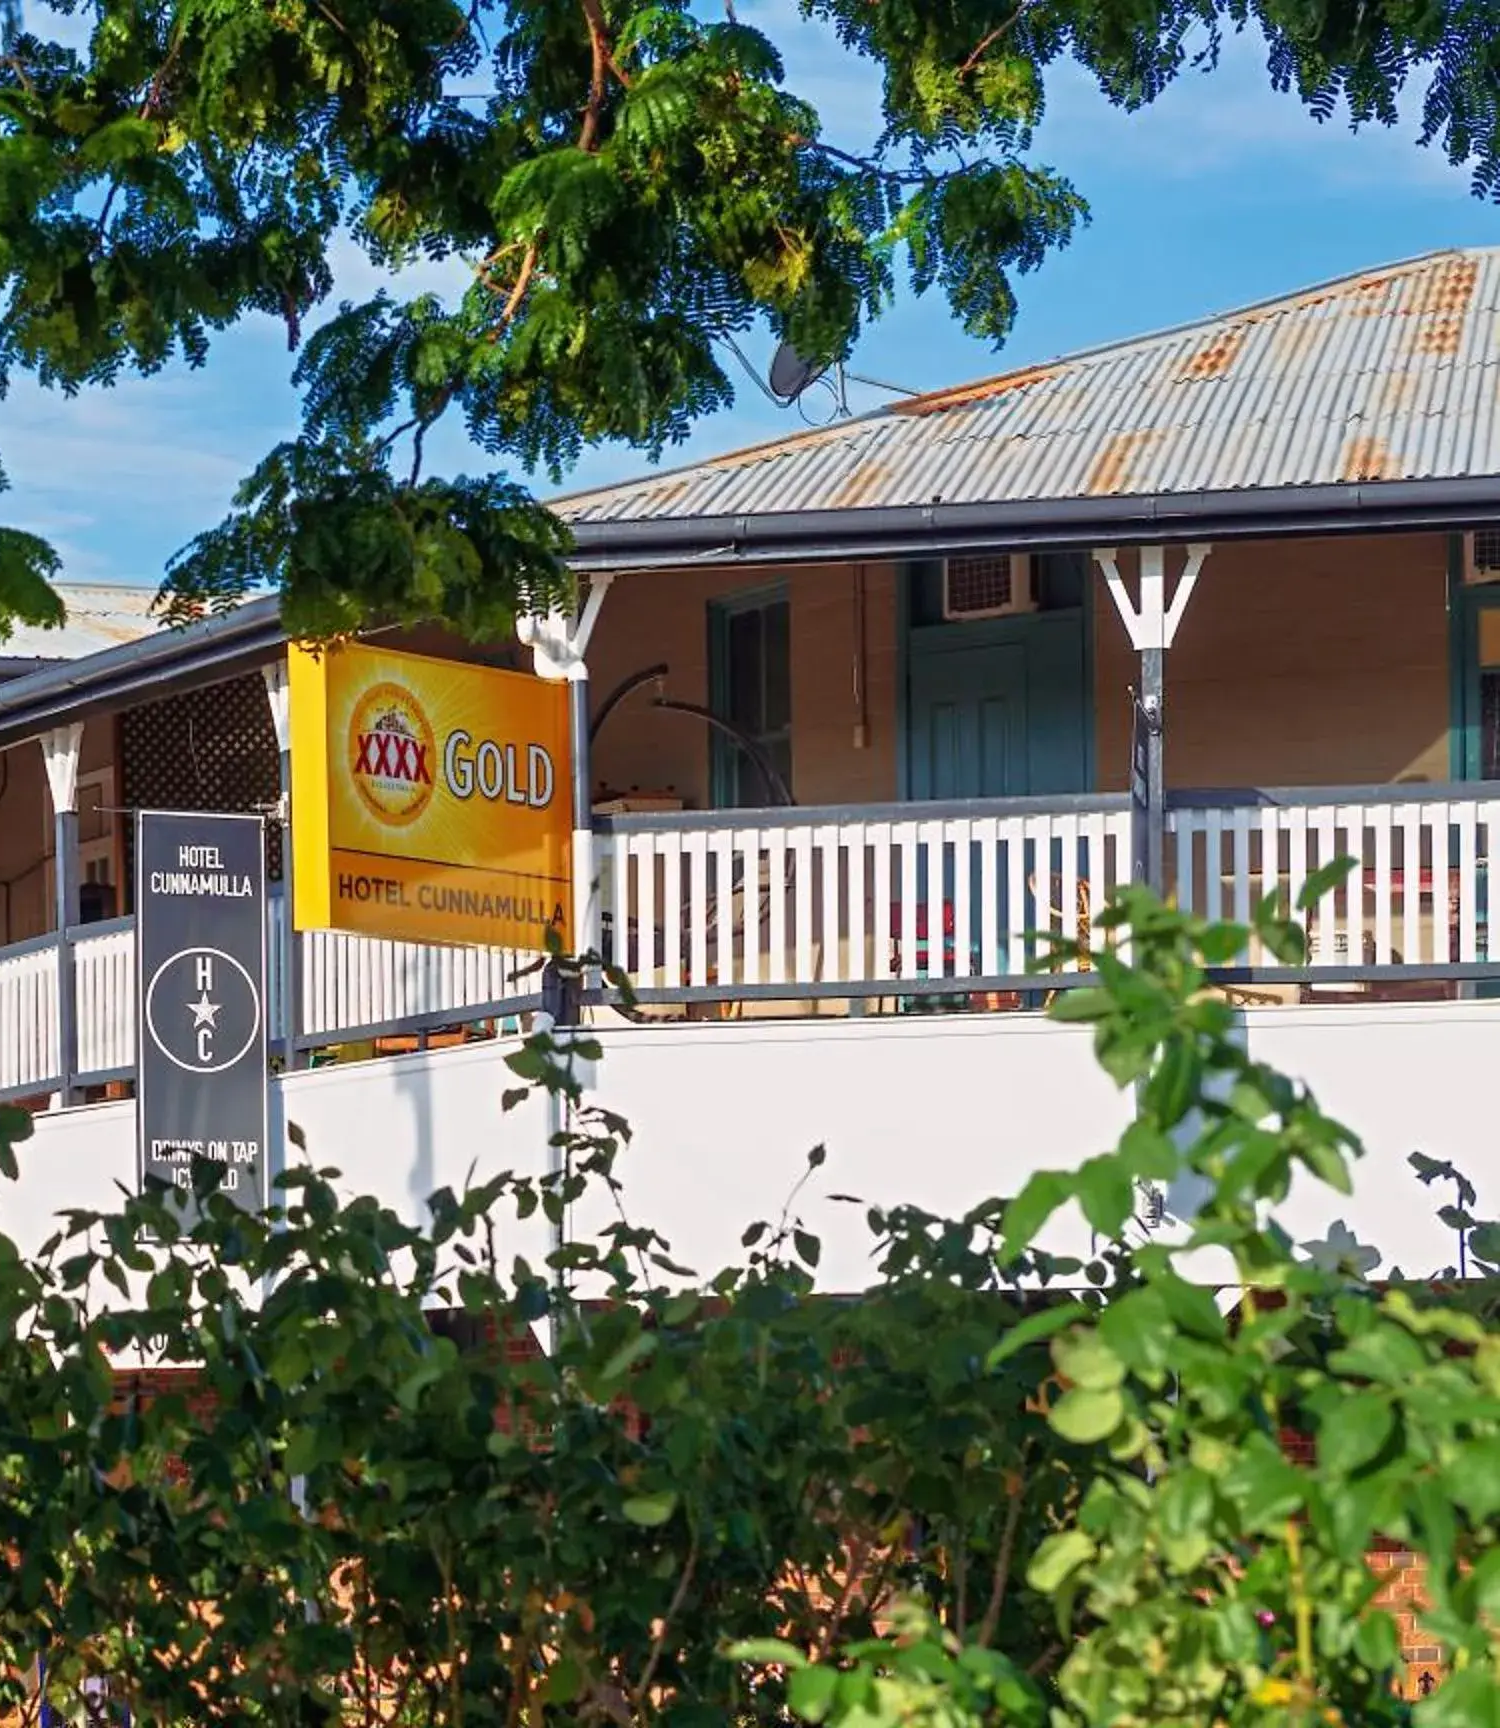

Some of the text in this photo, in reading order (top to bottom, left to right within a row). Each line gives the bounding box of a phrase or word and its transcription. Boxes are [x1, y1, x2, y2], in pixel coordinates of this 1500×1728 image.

[355, 733, 431, 785] XXXX
[444, 729, 554, 808] GOLD
[180, 846, 224, 868] HOTEL
[151, 872, 252, 897] CUNNAMULLA
[339, 873, 566, 927] HOTEL CUNNAMULLA
[196, 957, 212, 990] H
[197, 1028, 213, 1062] C
[208, 1140, 227, 1162] ON
[231, 1141, 257, 1163] TAP
